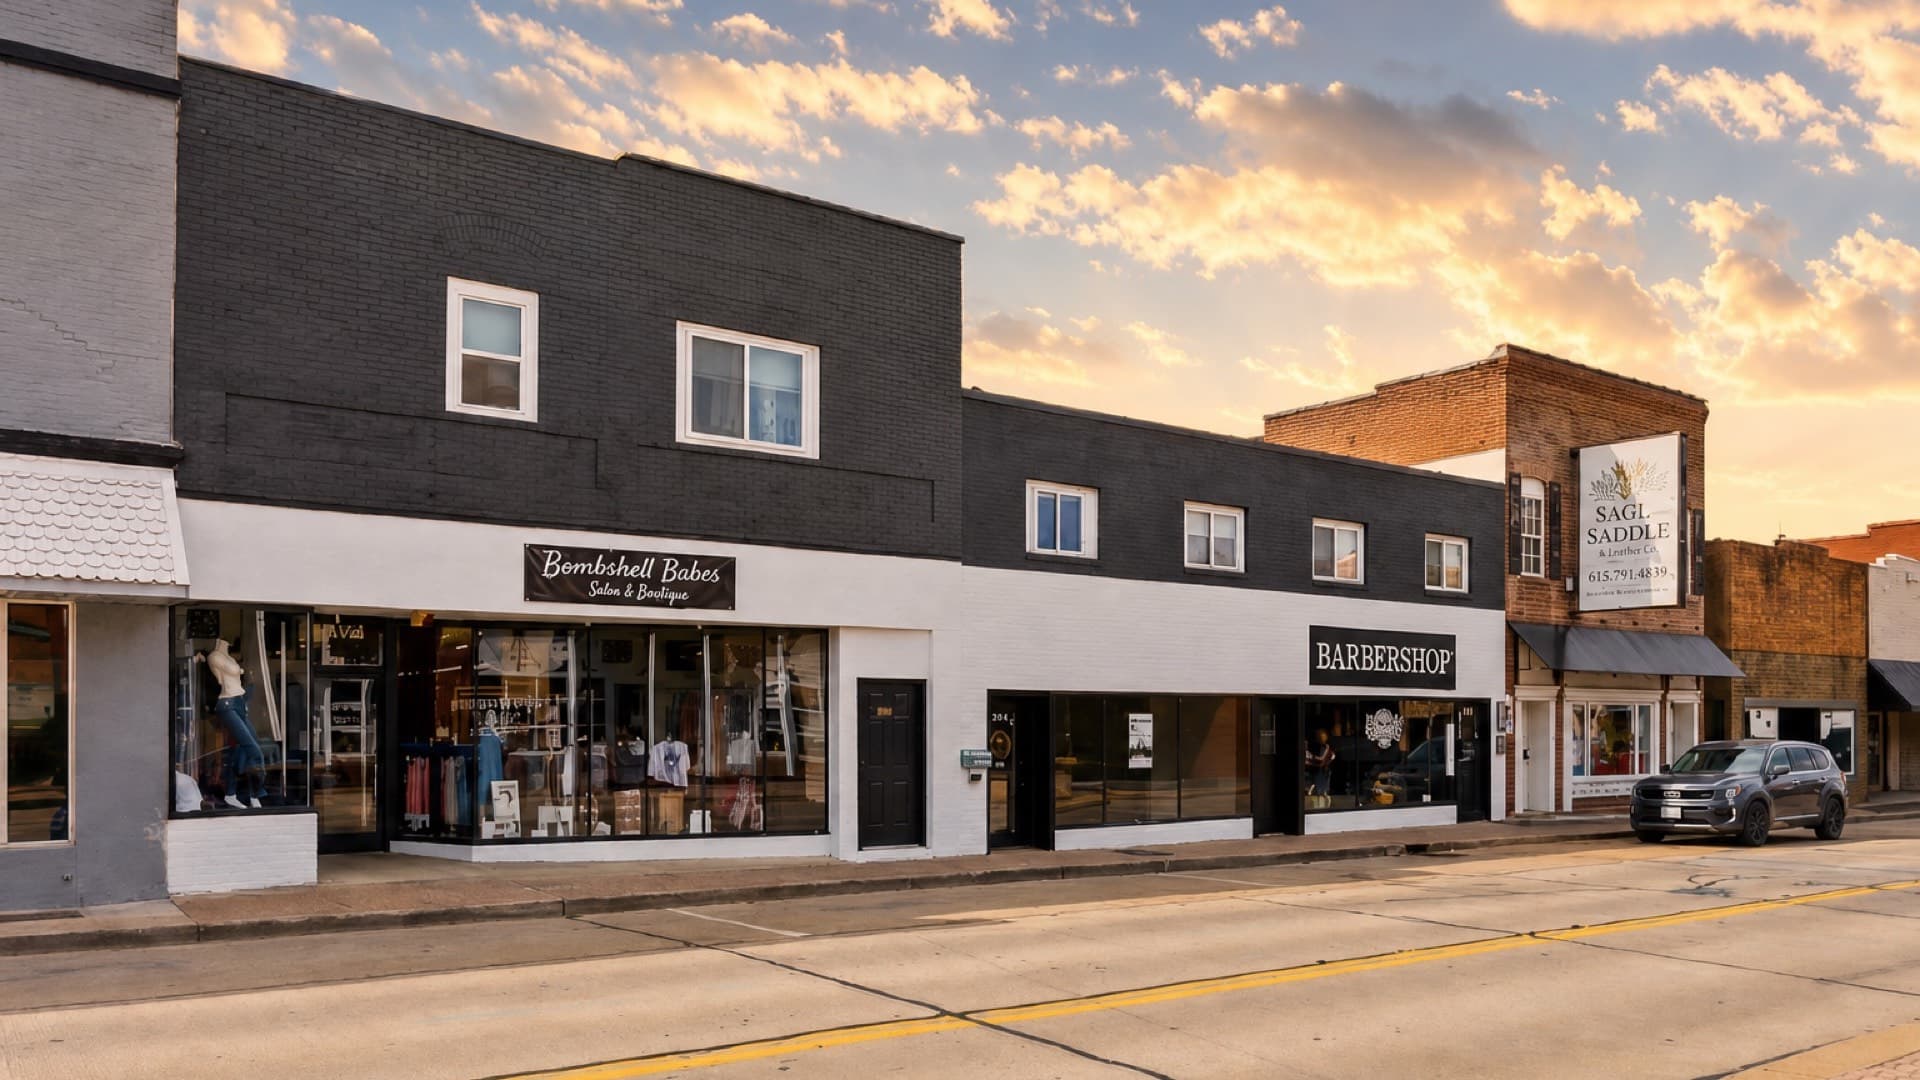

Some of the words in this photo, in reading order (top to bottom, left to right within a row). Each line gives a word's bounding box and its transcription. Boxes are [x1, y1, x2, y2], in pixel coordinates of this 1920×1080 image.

[1587, 522, 1670, 544] SADDLE
[1599, 549, 1606, 557] &
[541, 549, 655, 579] Bombshell
[661, 557, 721, 583] Babes
[1588, 566, 1667, 583] 615.791.4839
[588, 580, 621, 597] Salon
[624, 583, 635, 598] &
[1316, 642, 1451, 675] BARBERSHOP
